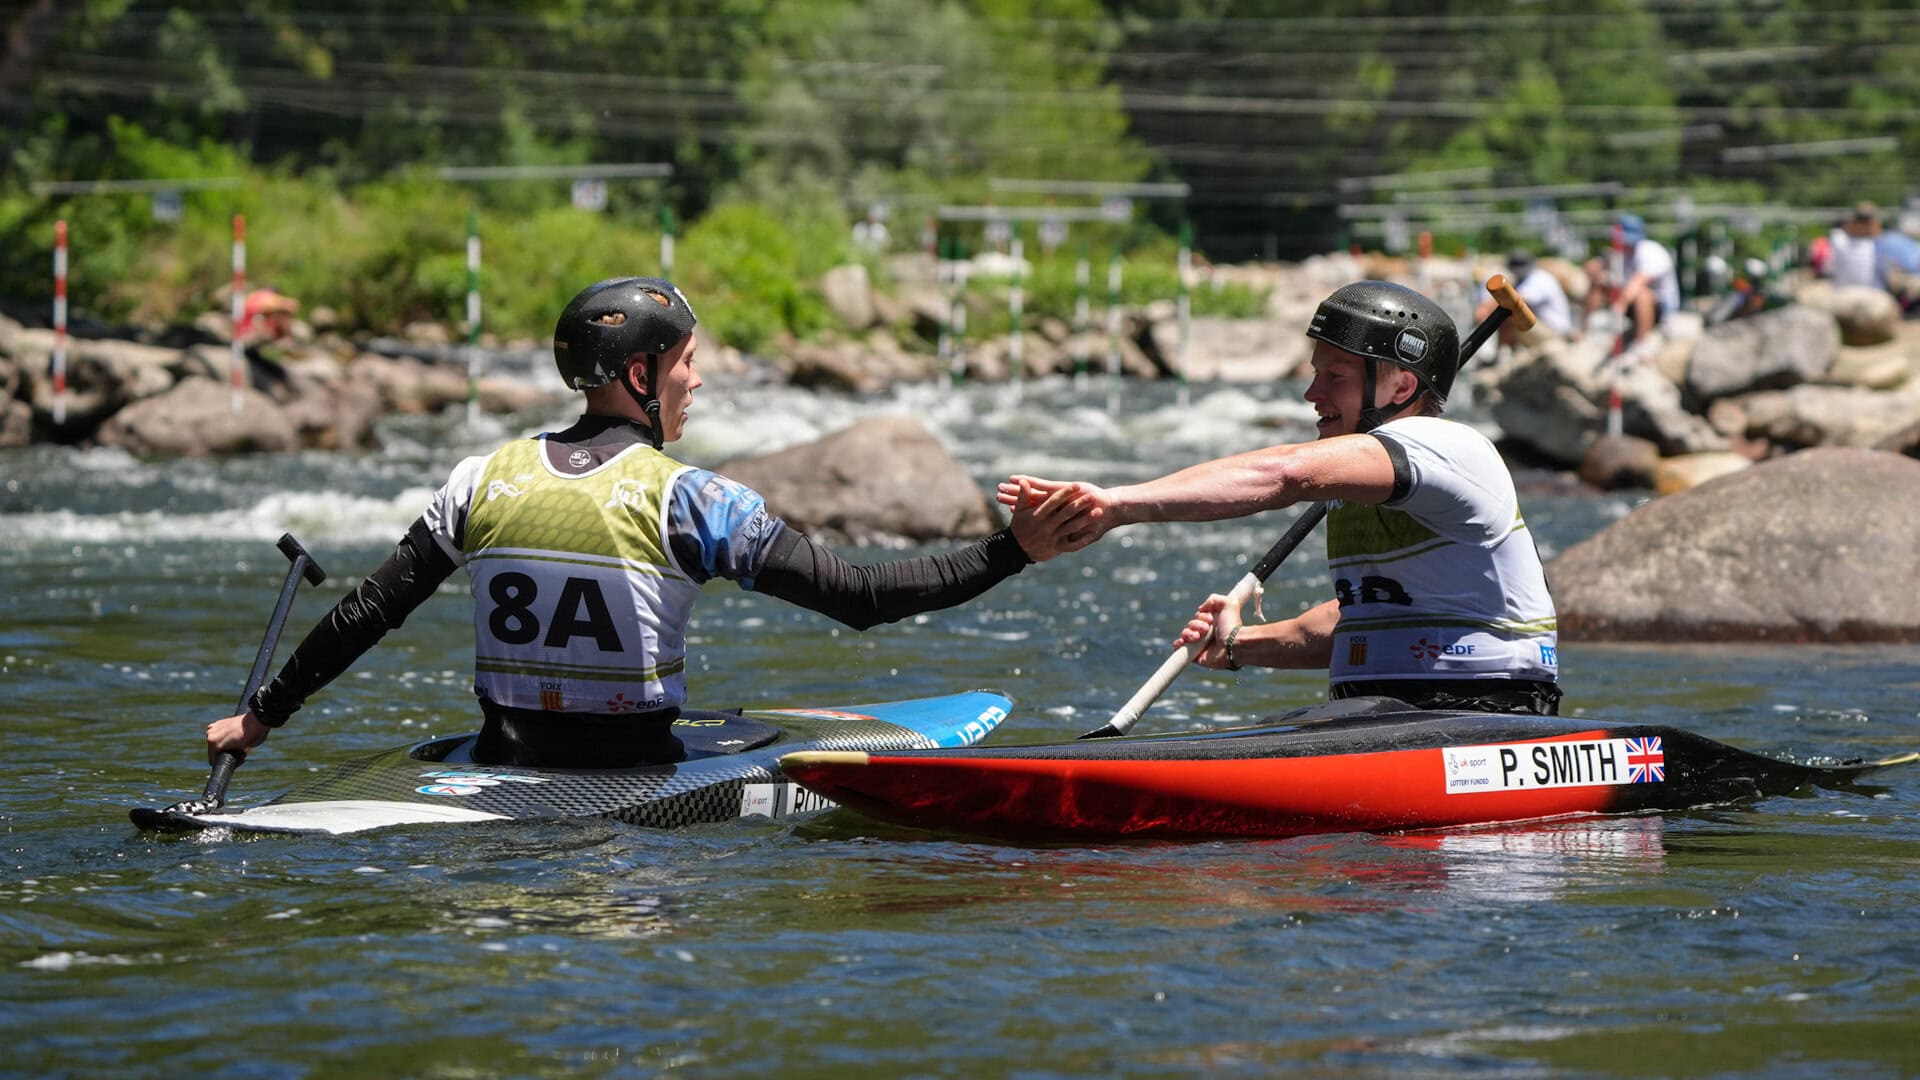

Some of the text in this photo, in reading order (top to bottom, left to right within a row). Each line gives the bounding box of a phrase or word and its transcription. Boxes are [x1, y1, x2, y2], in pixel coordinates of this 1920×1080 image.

[488, 571, 625, 653] 8A
[540, 682, 562, 691] FOIX
[1469, 758, 1487, 768] sport
[1500, 742, 1617, 787] P. SMITH
[1450, 777, 1489, 787] LOTTERY FUNDED
